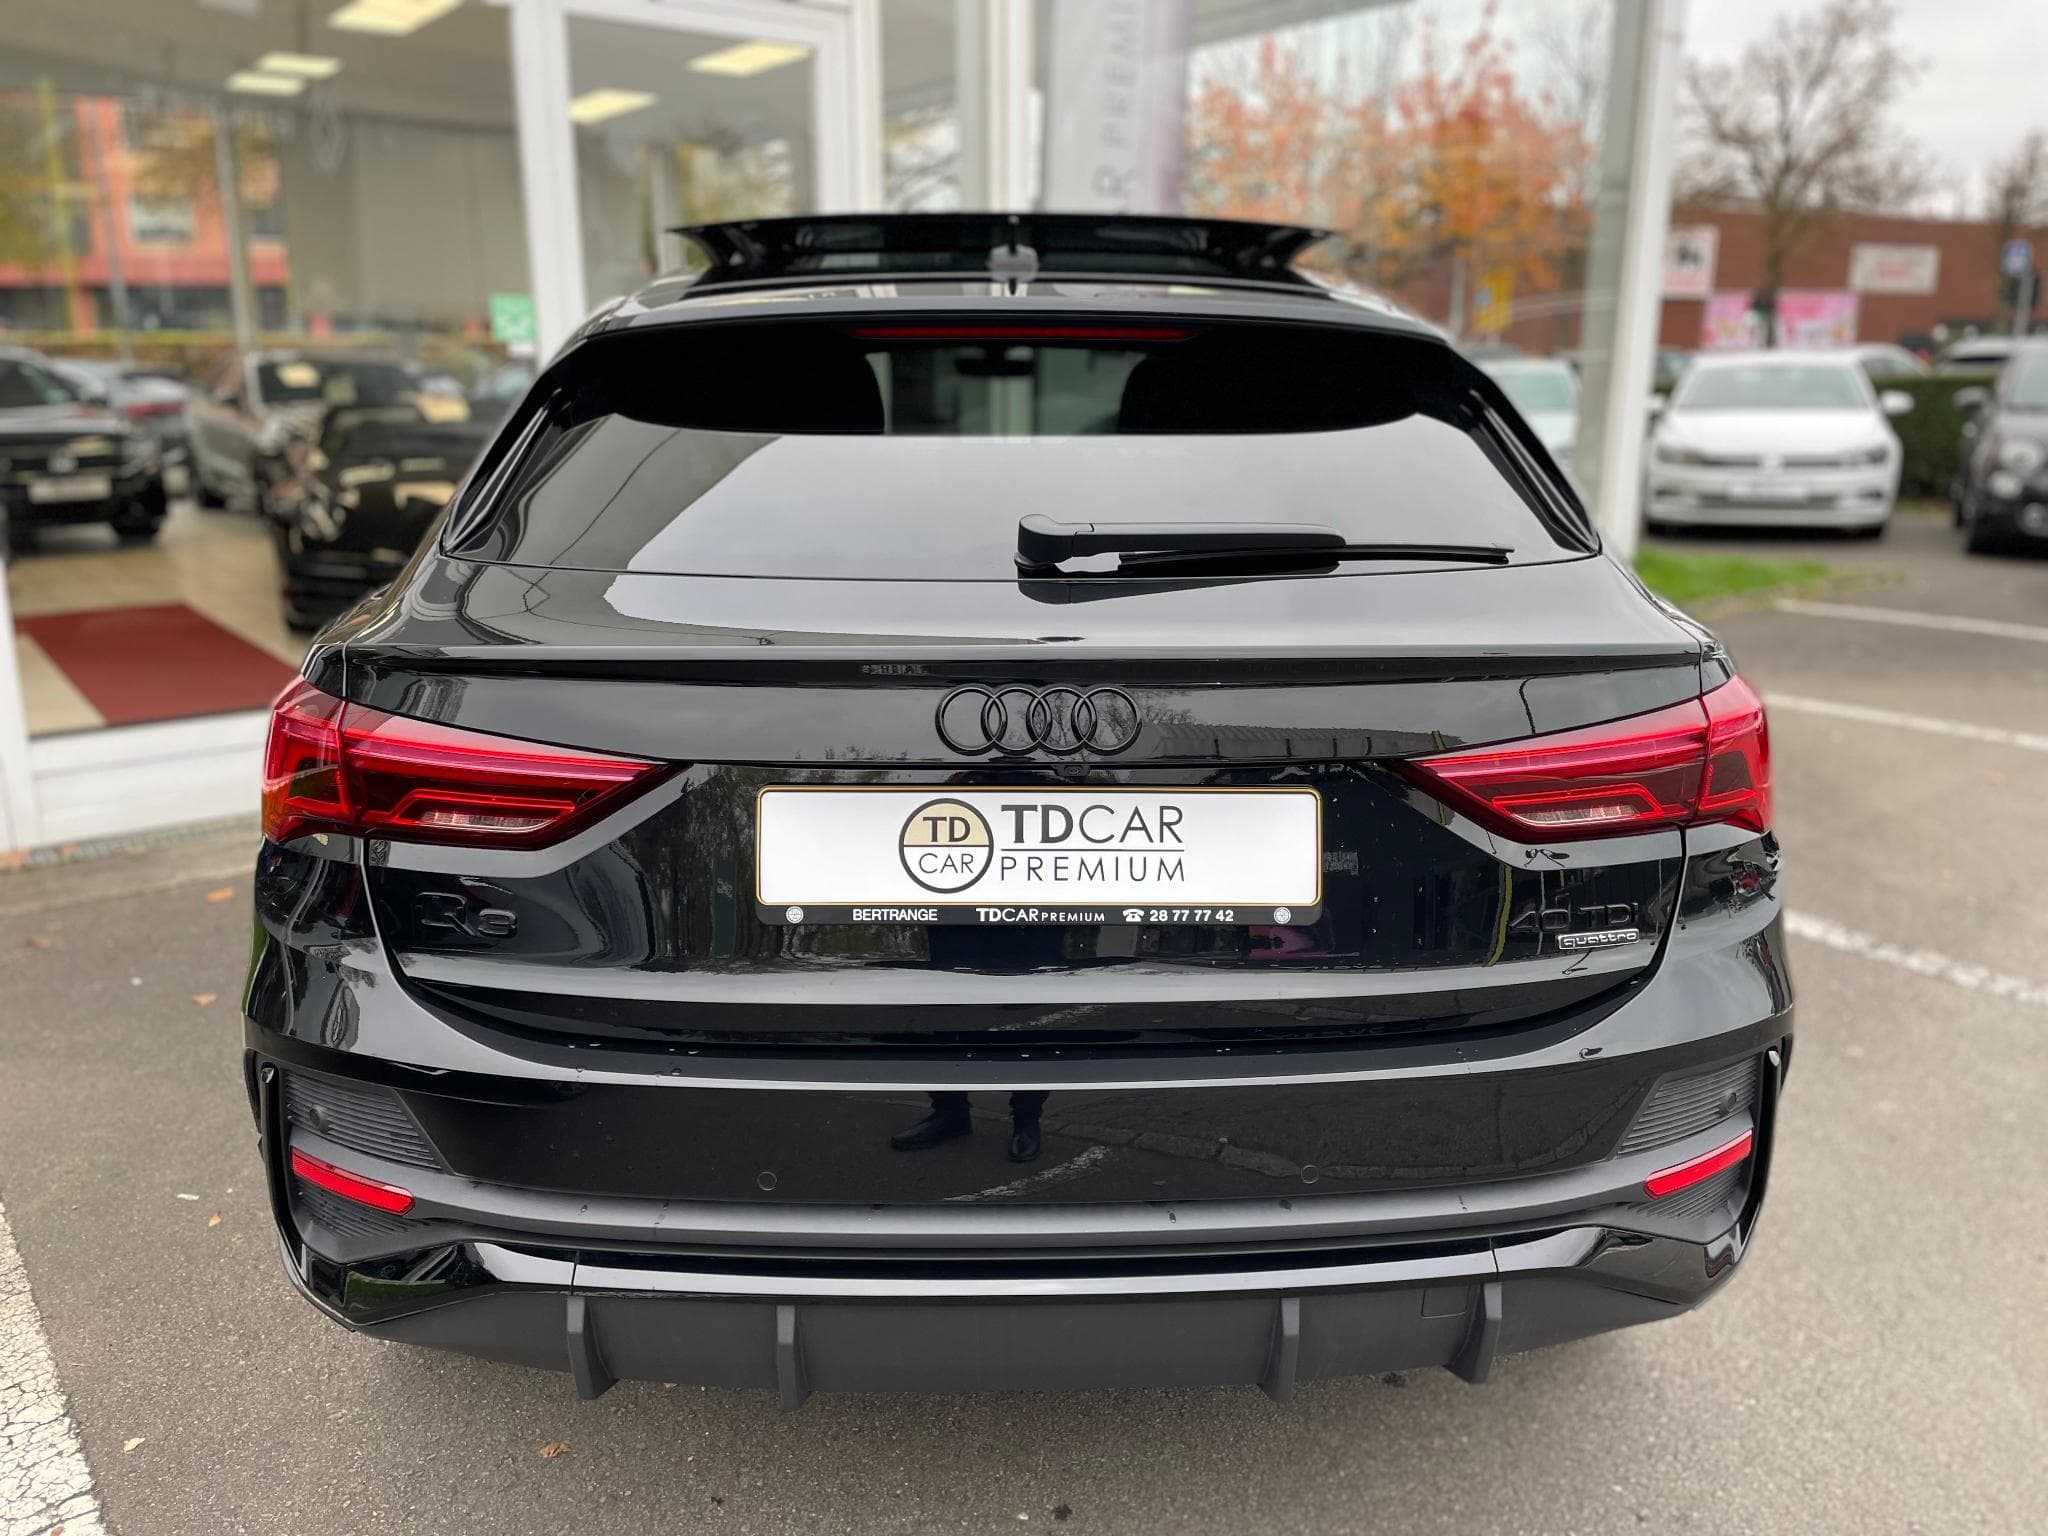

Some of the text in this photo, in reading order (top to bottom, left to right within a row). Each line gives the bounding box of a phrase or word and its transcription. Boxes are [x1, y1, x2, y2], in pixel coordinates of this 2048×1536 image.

[922, 816, 972, 843] TD
[1001, 804, 1184, 844] TDCAR
[918, 852, 975, 874] CAR
[1001, 855, 1186, 882] PREMIUM
[415, 891, 518, 938] Q3
[852, 907, 1234, 922] BERTRANGE TDCAR PREMIUM 28 77 77 42
[1579, 901, 1640, 928] TDI
[1562, 931, 1638, 949] quattro
